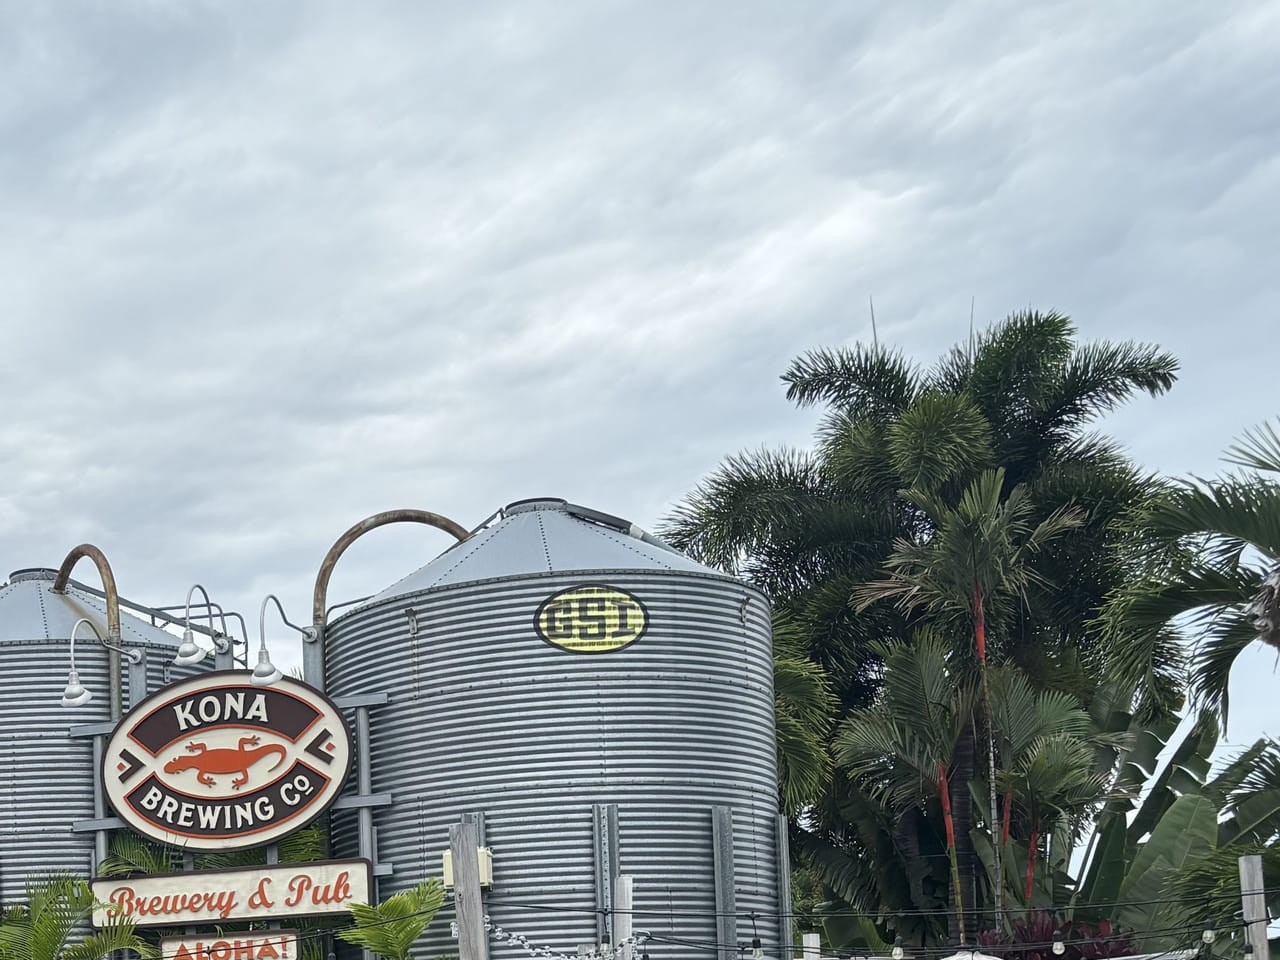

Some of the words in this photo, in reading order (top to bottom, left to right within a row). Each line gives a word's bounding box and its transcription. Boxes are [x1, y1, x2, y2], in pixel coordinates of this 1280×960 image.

[546, 597, 636, 640] GSI
[173, 692, 269, 731] KONA
[139, 785, 275, 830] BREWING
[106, 886, 239, 920] Brewery
[247, 876, 275, 910] &
[284, 871, 353, 909] Pub
